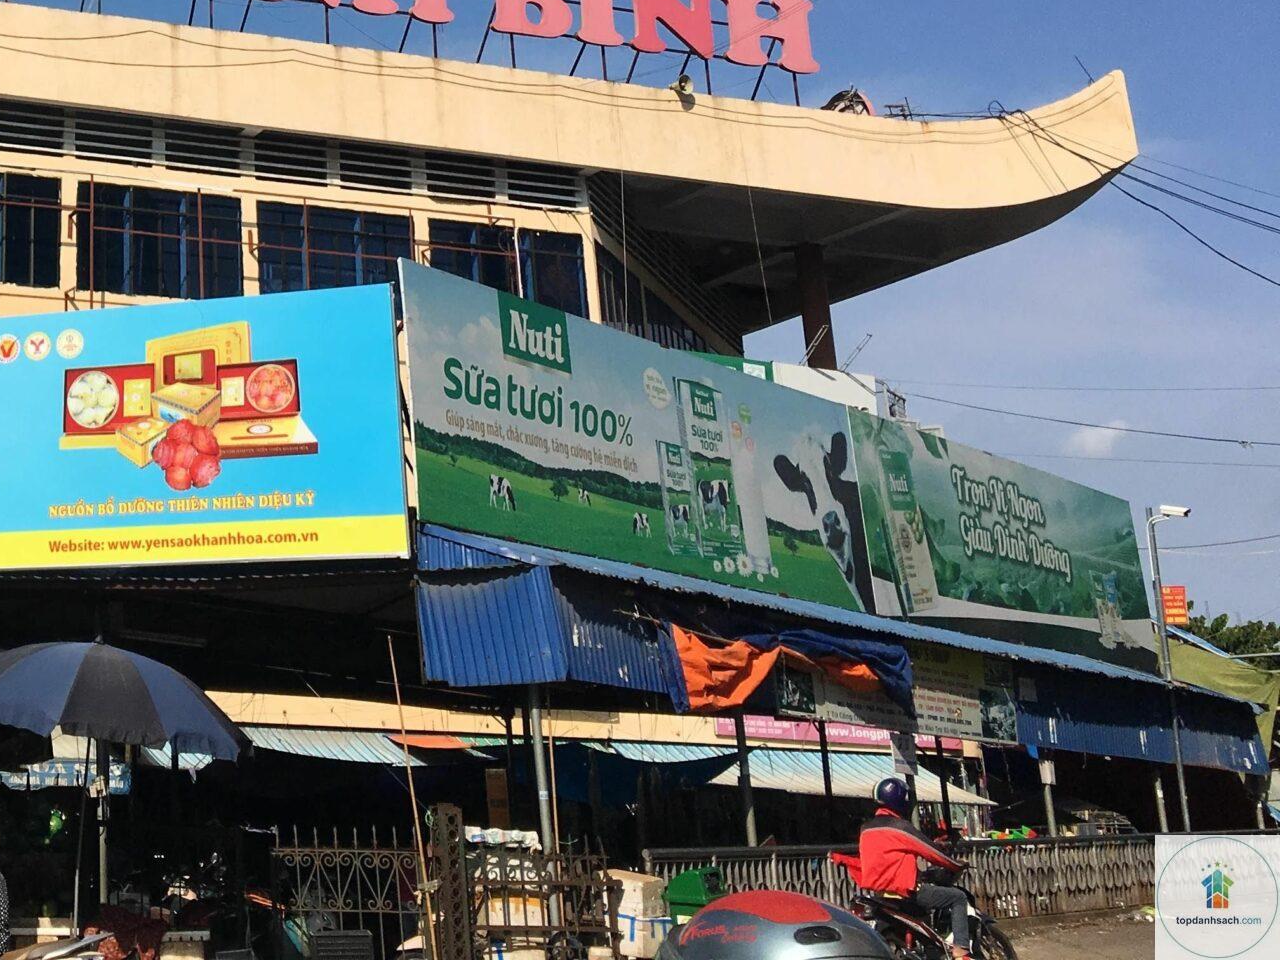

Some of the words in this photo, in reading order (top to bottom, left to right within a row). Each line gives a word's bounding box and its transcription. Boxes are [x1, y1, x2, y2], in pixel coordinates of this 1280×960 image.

[508, 308, 565, 364] Nuti
[443, 357, 501, 412] Sữa
[506, 373, 563, 428] tươi
[569, 399, 634, 447] 100%
[693, 395, 715, 418] Nuti
[445, 408, 465, 432] Giúp
[888, 473, 909, 493] Nuti
[48, 498, 95, 518] NGUỒN
[118, 497, 165, 515] DƯỠNG
[167, 495, 210, 512] THIÊN
[212, 493, 255, 511] NHIÊN
[258, 490, 292, 510] DIỆU
[951, 466, 991, 513] Trọn
[988, 478, 1009, 521] Vị
[1006, 483, 1045, 529] Ngon
[48, 539, 105, 554] Website:
[107, 530, 319, 552] www.yensaokhanhhoa.com.vn
[959, 514, 995, 557] Giàu
